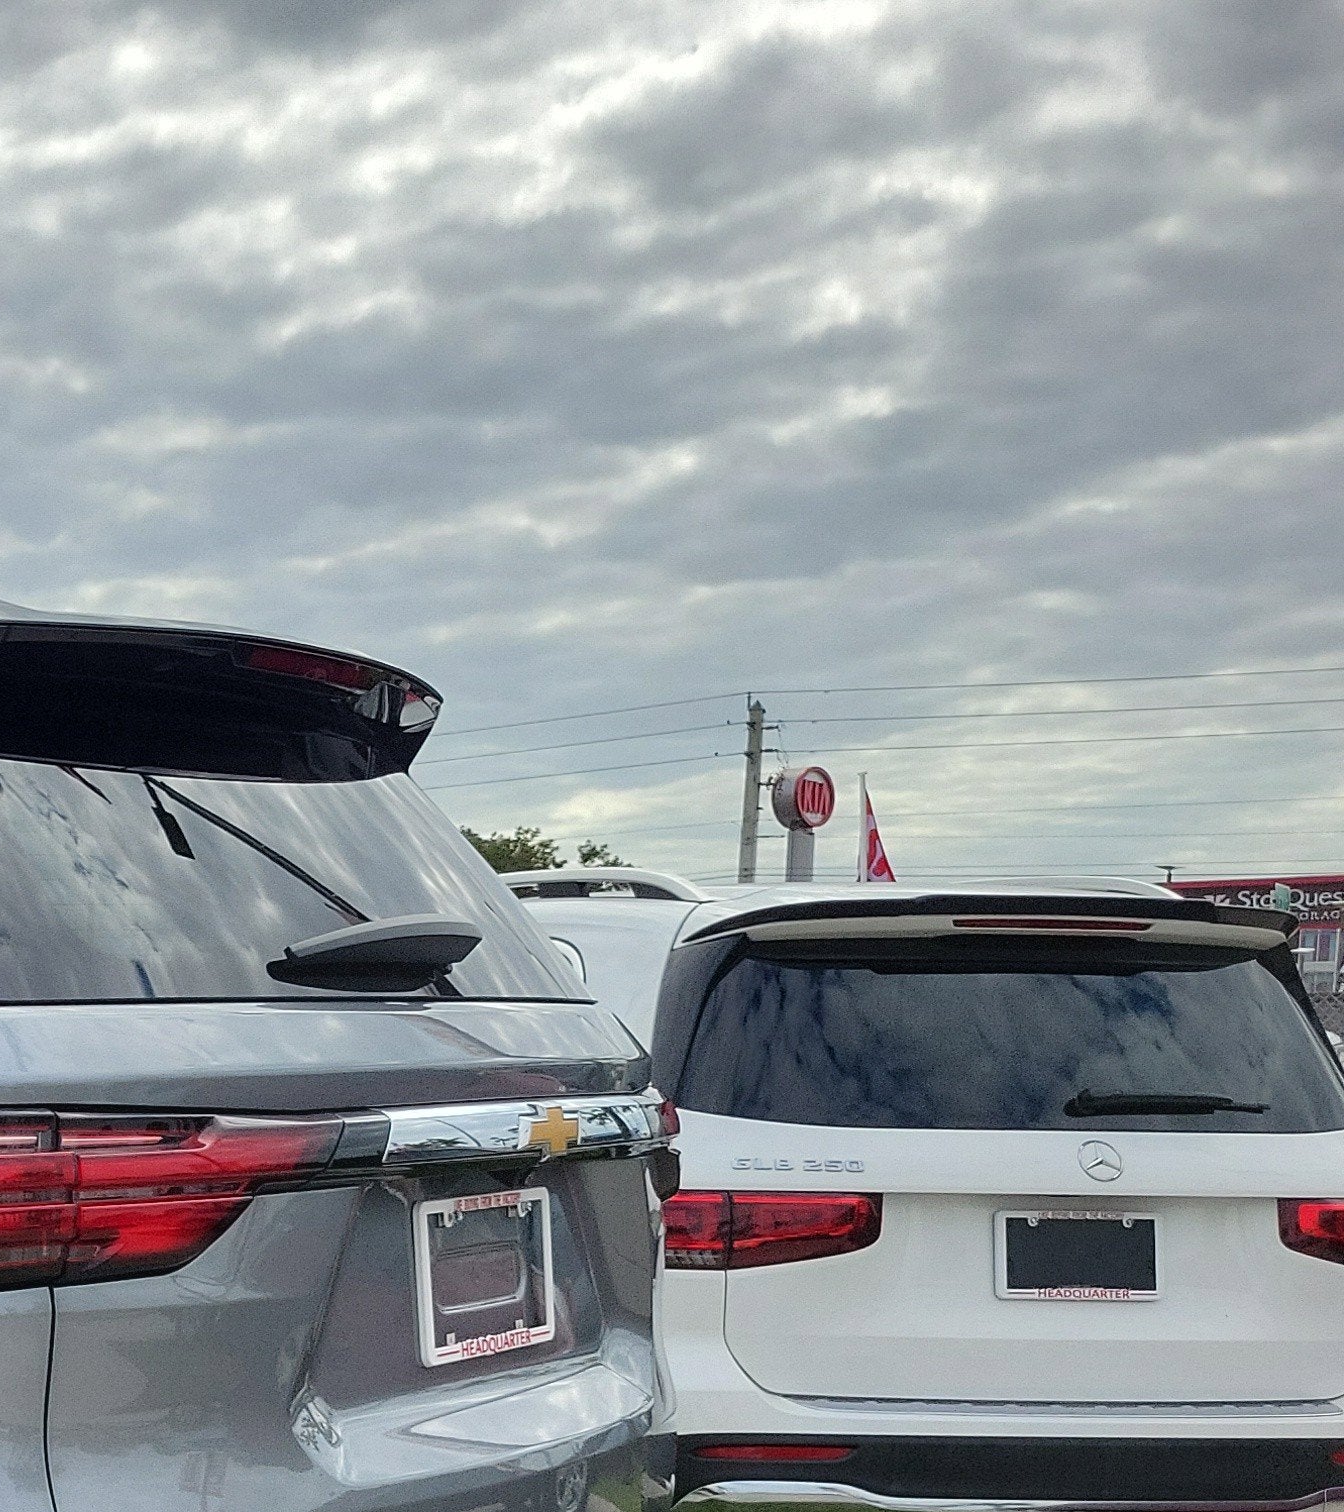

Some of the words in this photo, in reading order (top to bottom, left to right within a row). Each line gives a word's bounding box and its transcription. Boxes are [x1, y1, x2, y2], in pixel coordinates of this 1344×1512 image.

[732, 1158, 793, 1171] GLB
[803, 1160, 864, 1173] 250
[1037, 1289, 1130, 1299] HEADQUARTER
[461, 1329, 532, 1357] HEADQUARTER
